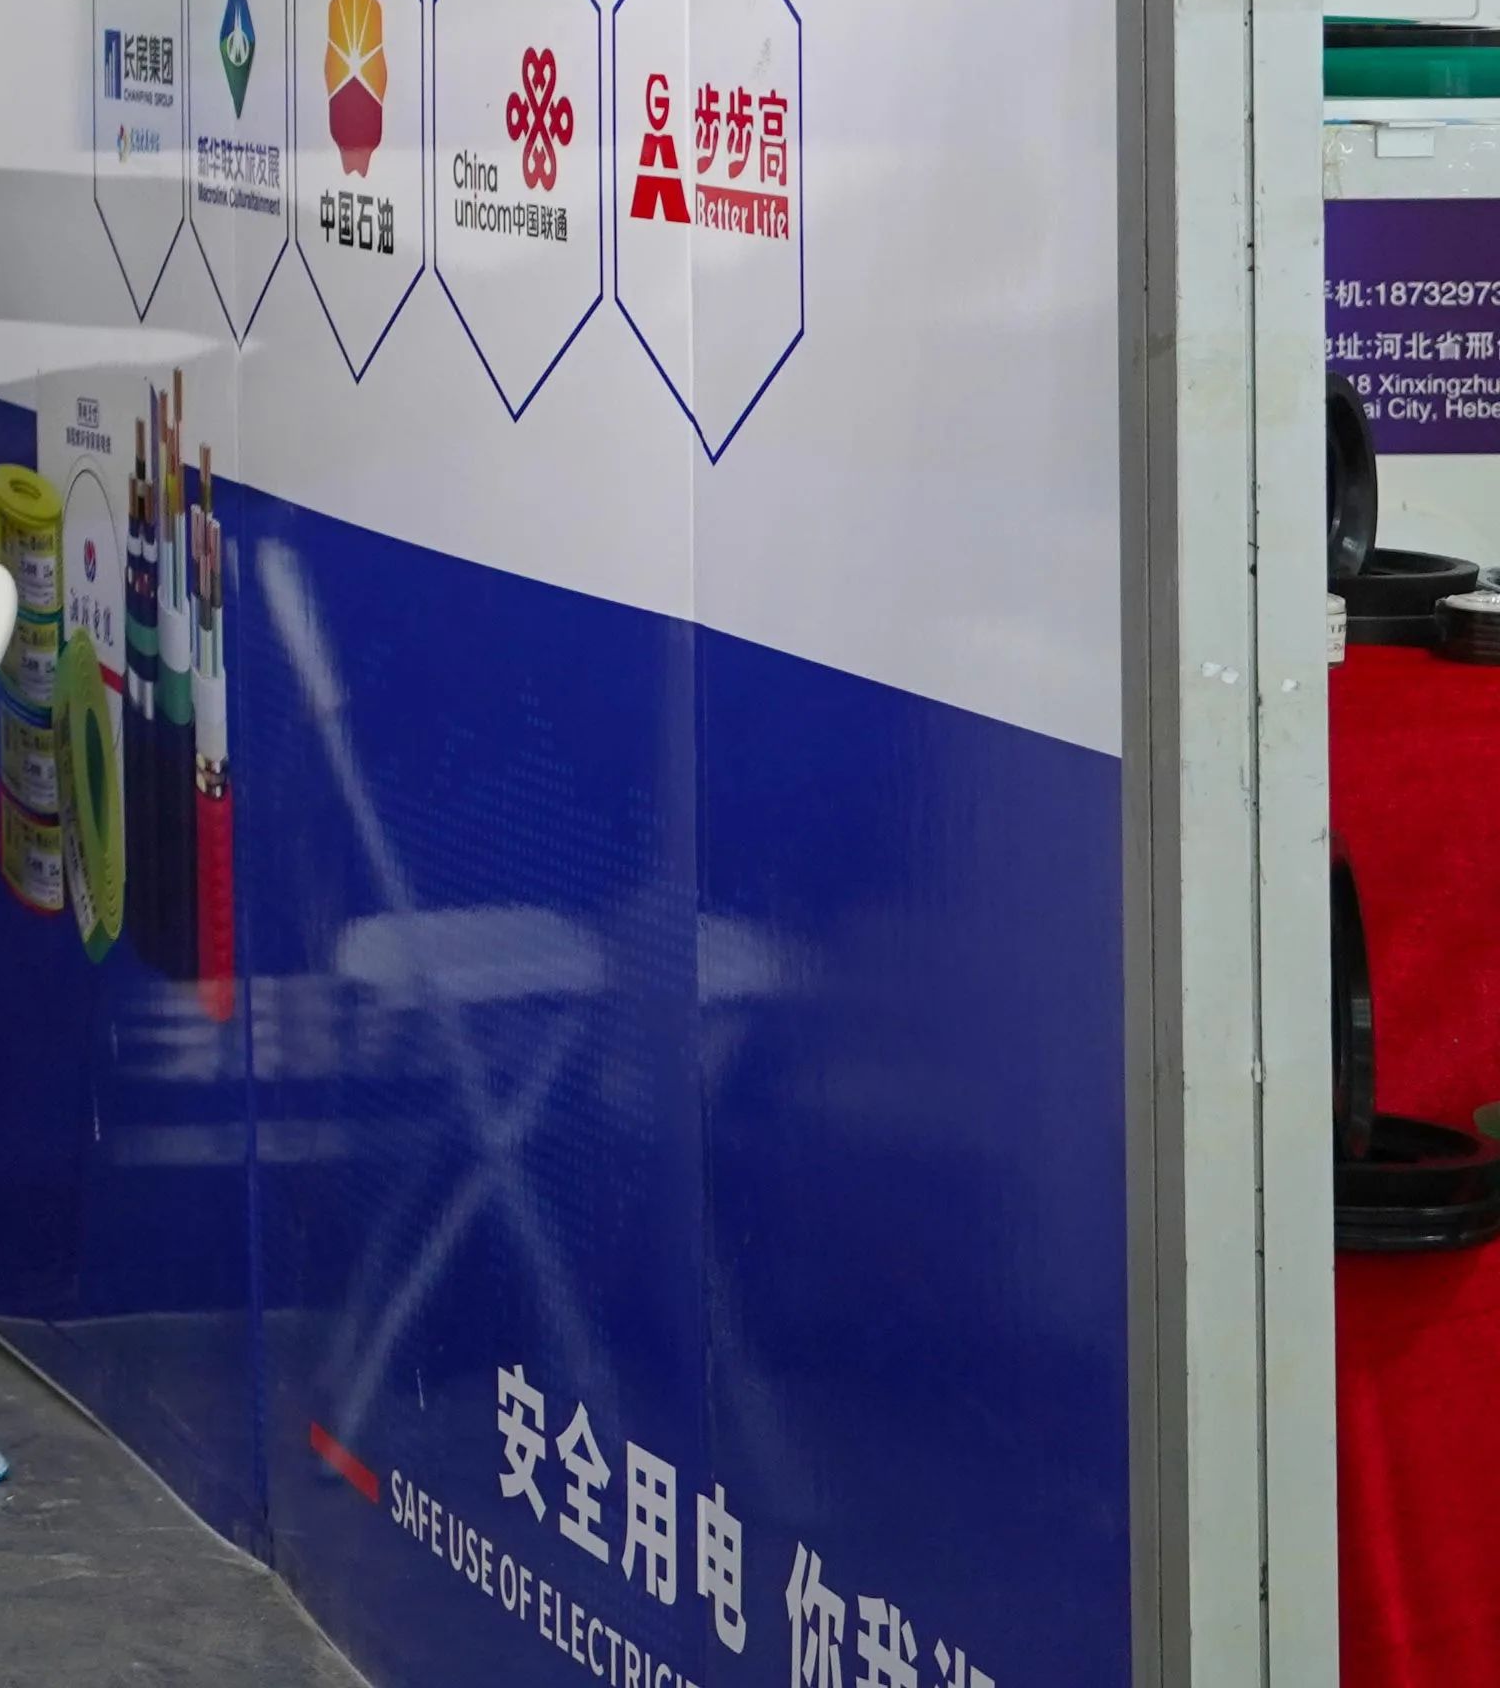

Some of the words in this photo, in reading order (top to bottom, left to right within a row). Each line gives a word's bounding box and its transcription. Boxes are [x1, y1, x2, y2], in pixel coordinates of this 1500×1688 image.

[124, 32, 173, 86] 长房集团
[696, 81, 789, 189] 步步高
[197, 136, 280, 189] 新华联文旅发展
[453, 150, 499, 194] China
[319, 190, 395, 255] 中国石油
[696, 189, 750, 233] Better
[753, 196, 789, 241] Life
[1388, 398, 1438, 424] City,
[498, 1364, 748, 1654] 安全用电
[392, 1468, 444, 1557] SAFE
[449, 1526, 494, 1596] USE
[500, 1559, 532, 1624] OF
